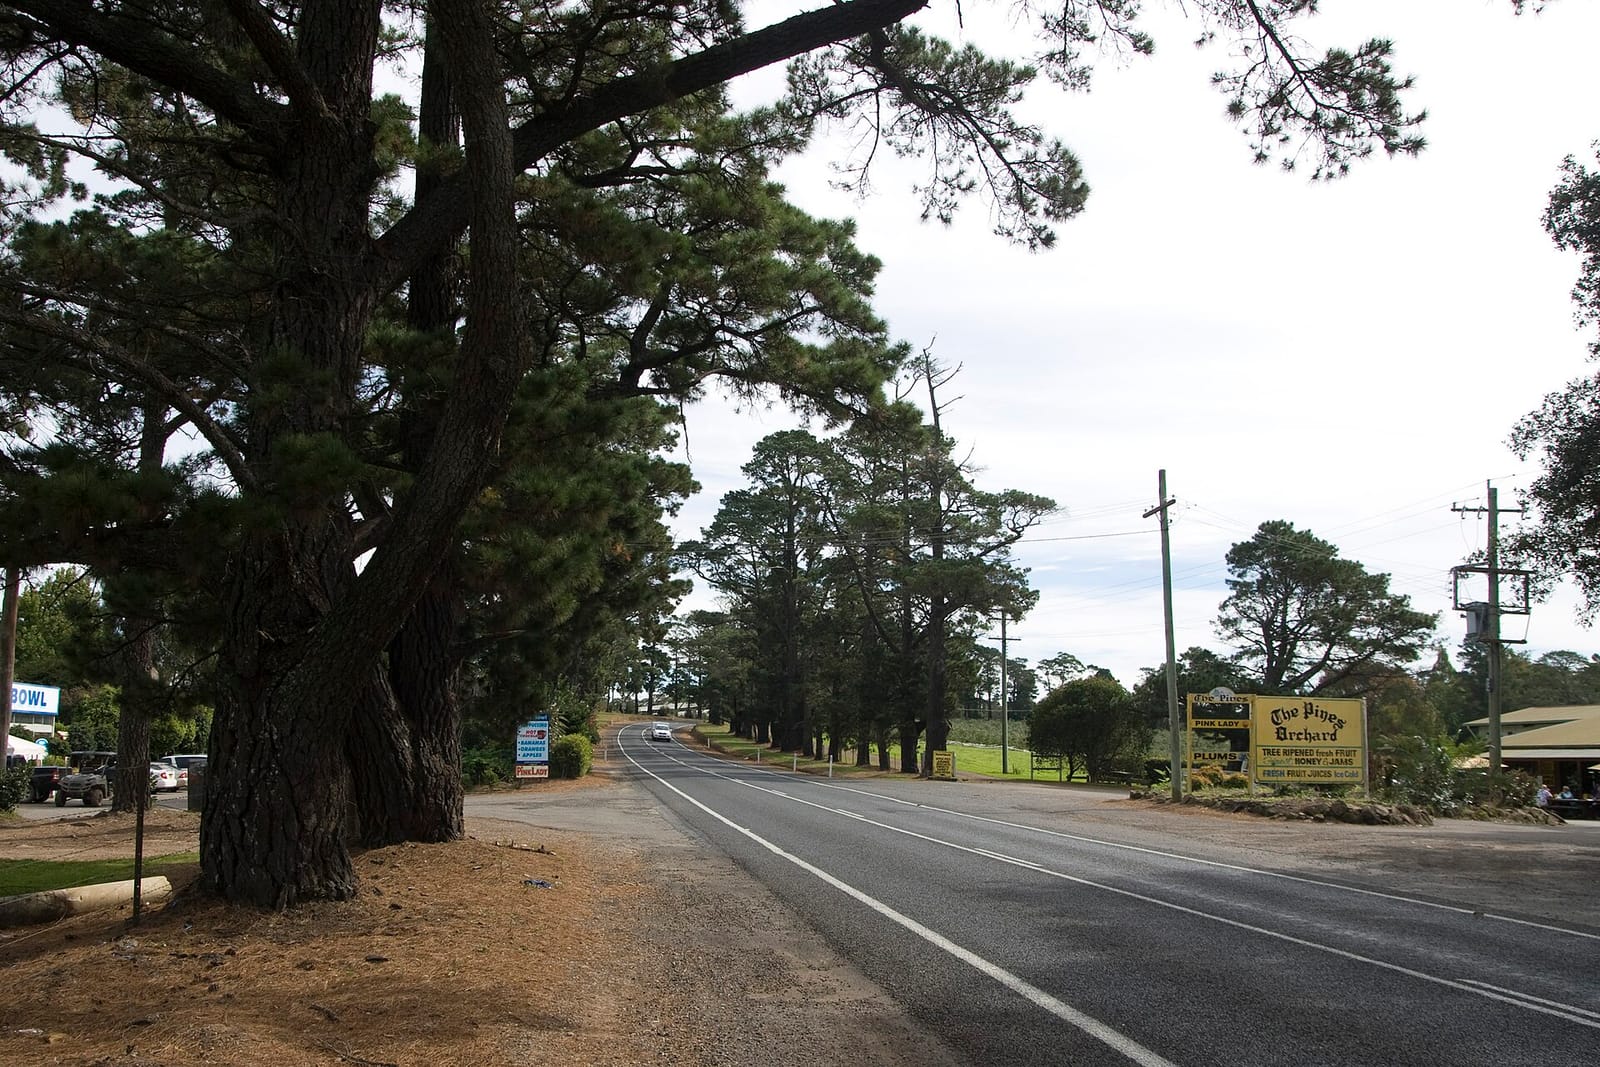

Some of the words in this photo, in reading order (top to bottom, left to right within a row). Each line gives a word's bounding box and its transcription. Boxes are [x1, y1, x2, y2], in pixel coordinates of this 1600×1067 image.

[11, 688, 47, 706] BOWL
[1220, 694, 1249, 702] Pines
[1270, 706, 1299, 726] The
[1303, 701, 1347, 730] Pines
[1275, 726, 1338, 743] Orchard
[1194, 752, 1237, 760] PLUMS
[1262, 748, 1281, 757] TREE
[1282, 748, 1315, 757] RIPENED
[1316, 749, 1334, 757] fresh
[1335, 749, 1358, 758] FRUIT
[1294, 757, 1321, 766] HONEY
[1329, 758, 1354, 766] JAMS
[1263, 769, 1285, 778] FRESH
[1287, 769, 1307, 778] FRUIT
[1307, 769, 1333, 778] JUICES
